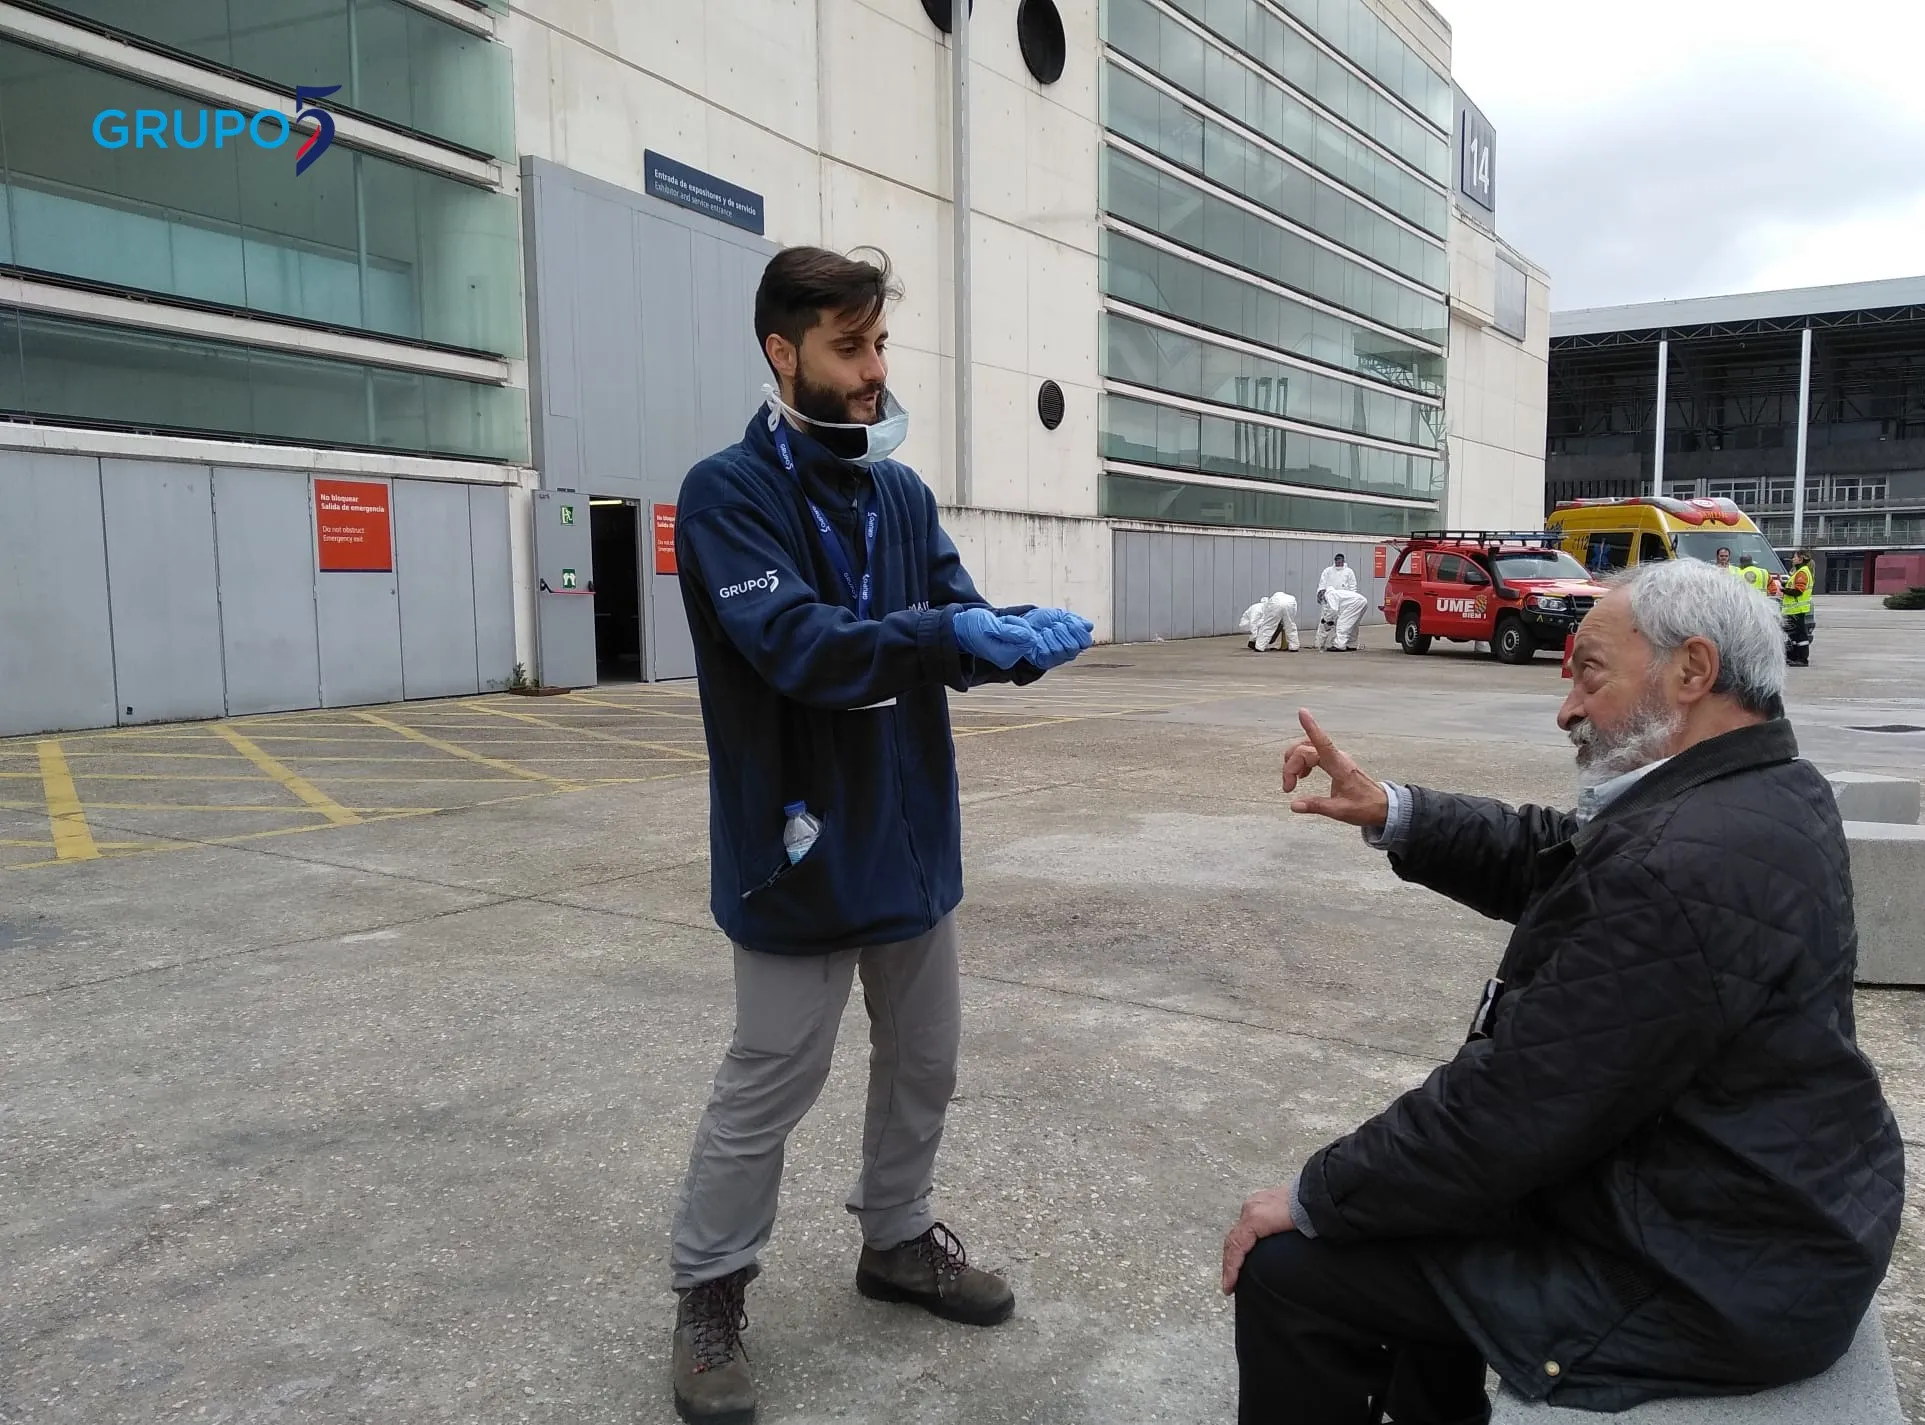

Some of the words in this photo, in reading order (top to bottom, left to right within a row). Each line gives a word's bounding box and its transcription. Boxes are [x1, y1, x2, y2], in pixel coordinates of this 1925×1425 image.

[1470, 137, 1490, 195] 14
[654, 181, 679, 197] Exhibitor
[680, 191, 691, 202] and
[691, 196, 709, 209] service
[711, 204, 732, 217] entrance
[655, 169, 678, 185] Entrada
[679, 179, 688, 190] de
[688, 183, 722, 203] expositores
[722, 197, 727, 206] y
[727, 197, 735, 208] de
[735, 202, 757, 216] servicio
[779, 443, 794, 471] GRUPO5
[331, 494, 358, 502] bloquear
[350, 505, 384, 513] emergencia
[322, 525, 331, 533] Do
[342, 526, 365, 534] obstruct
[323, 535, 353, 543] Emergency
[719, 568, 780, 599] GRUPO5
[1436, 597, 1476, 613] UME
